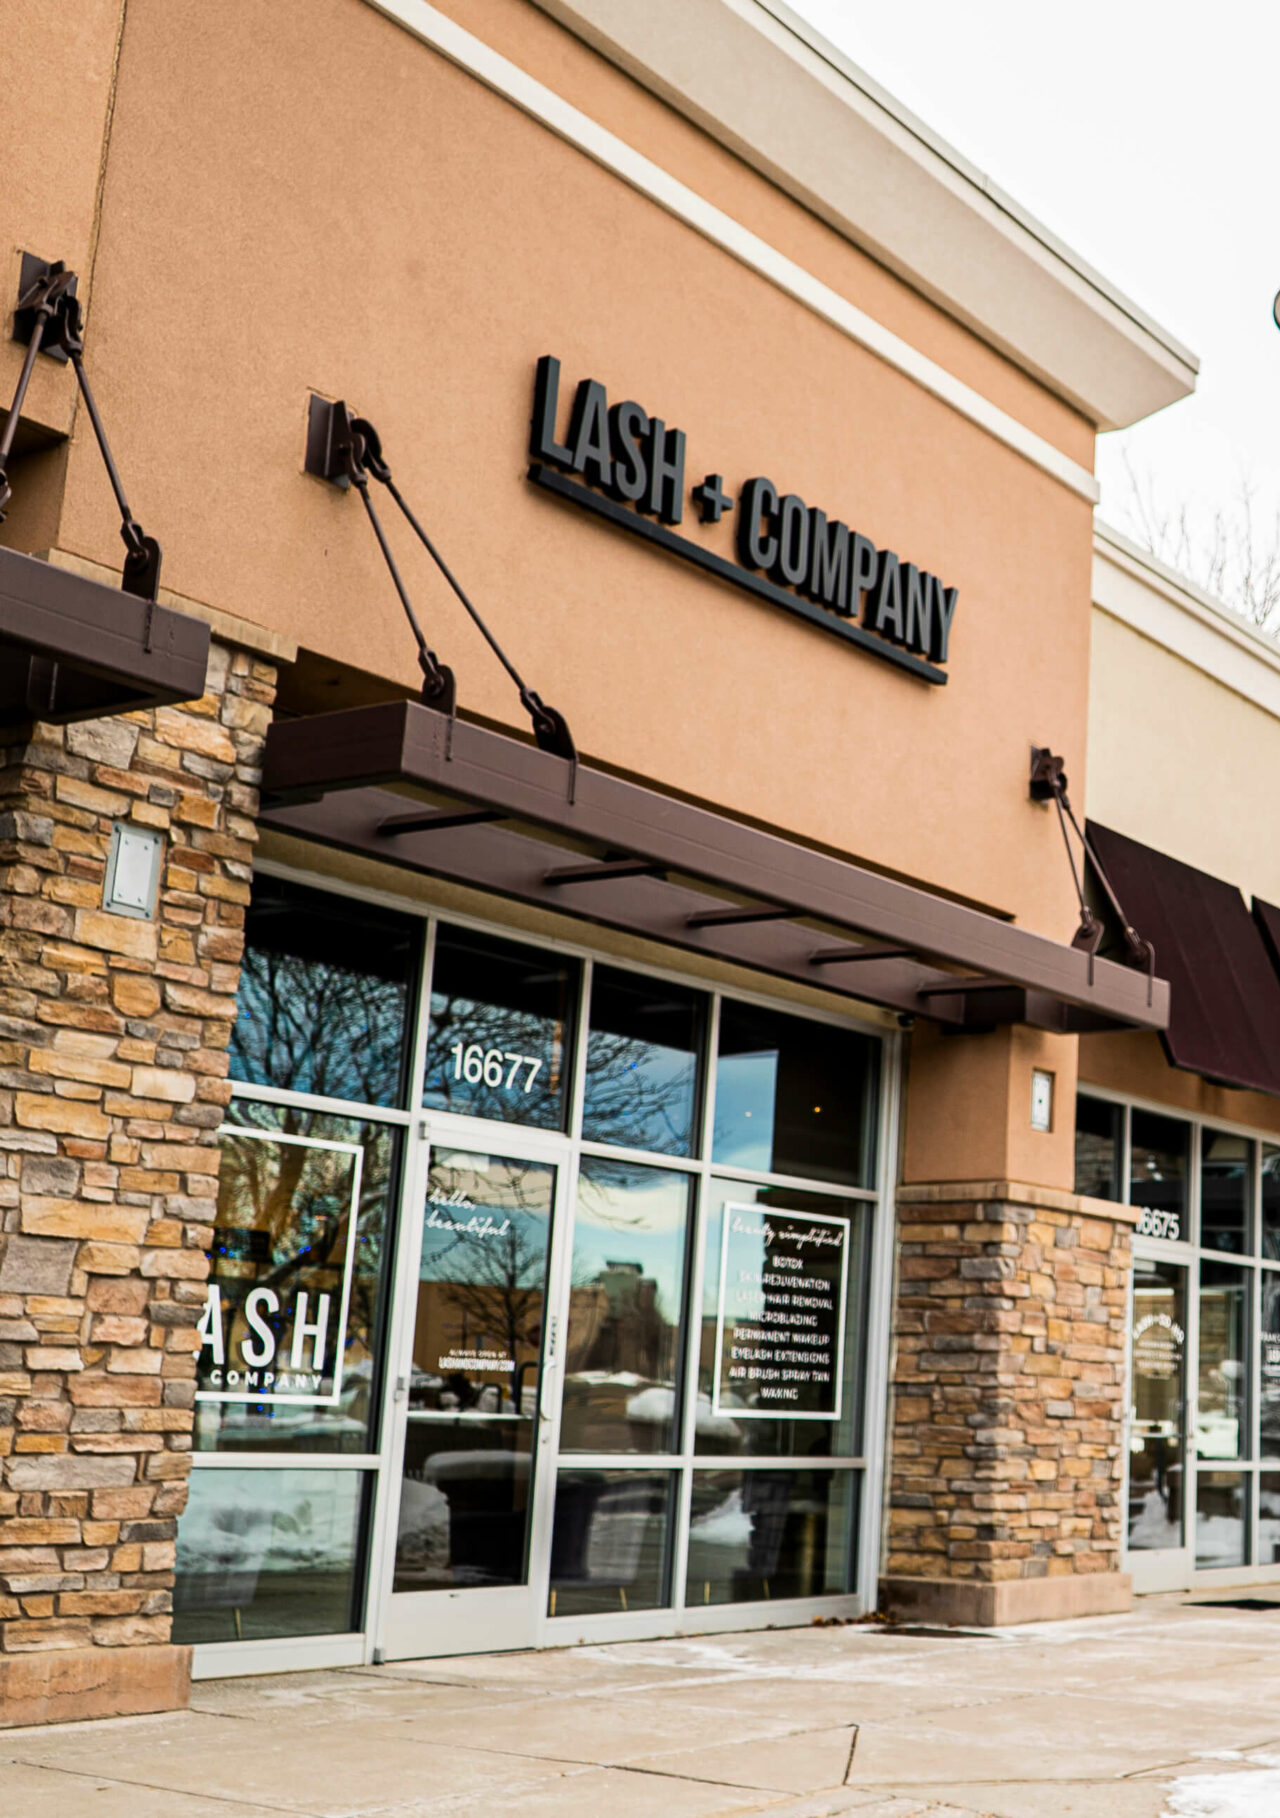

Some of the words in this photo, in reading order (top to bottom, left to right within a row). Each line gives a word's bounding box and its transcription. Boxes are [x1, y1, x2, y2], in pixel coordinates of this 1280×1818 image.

[530, 355, 686, 526] LASH
[736, 476, 959, 664] COMPANY
[451, 1042, 543, 1094] 16677
[425, 1209, 511, 1239] beautiful
[772, 1255, 804, 1270] BOTOX
[764, 1273, 831, 1291] REJUVENATION
[767, 1293, 791, 1305] HAIR
[792, 1294, 833, 1311] REMOVAL
[749, 1310, 818, 1327] MICROBLADING
[733, 1327, 791, 1343] PERMANENT
[792, 1332, 830, 1346] MAKEUP
[731, 1345, 773, 1360] EYELASH
[774, 1349, 830, 1365] EXTENSIONS
[210, 1369, 322, 1390] COMPANY
[728, 1366, 747, 1379] AIR
[748, 1366, 780, 1380] BRUSH
[781, 1368, 811, 1382] SPRAY
[812, 1370, 830, 1383] TAN
[760, 1386, 799, 1400] WAXING
